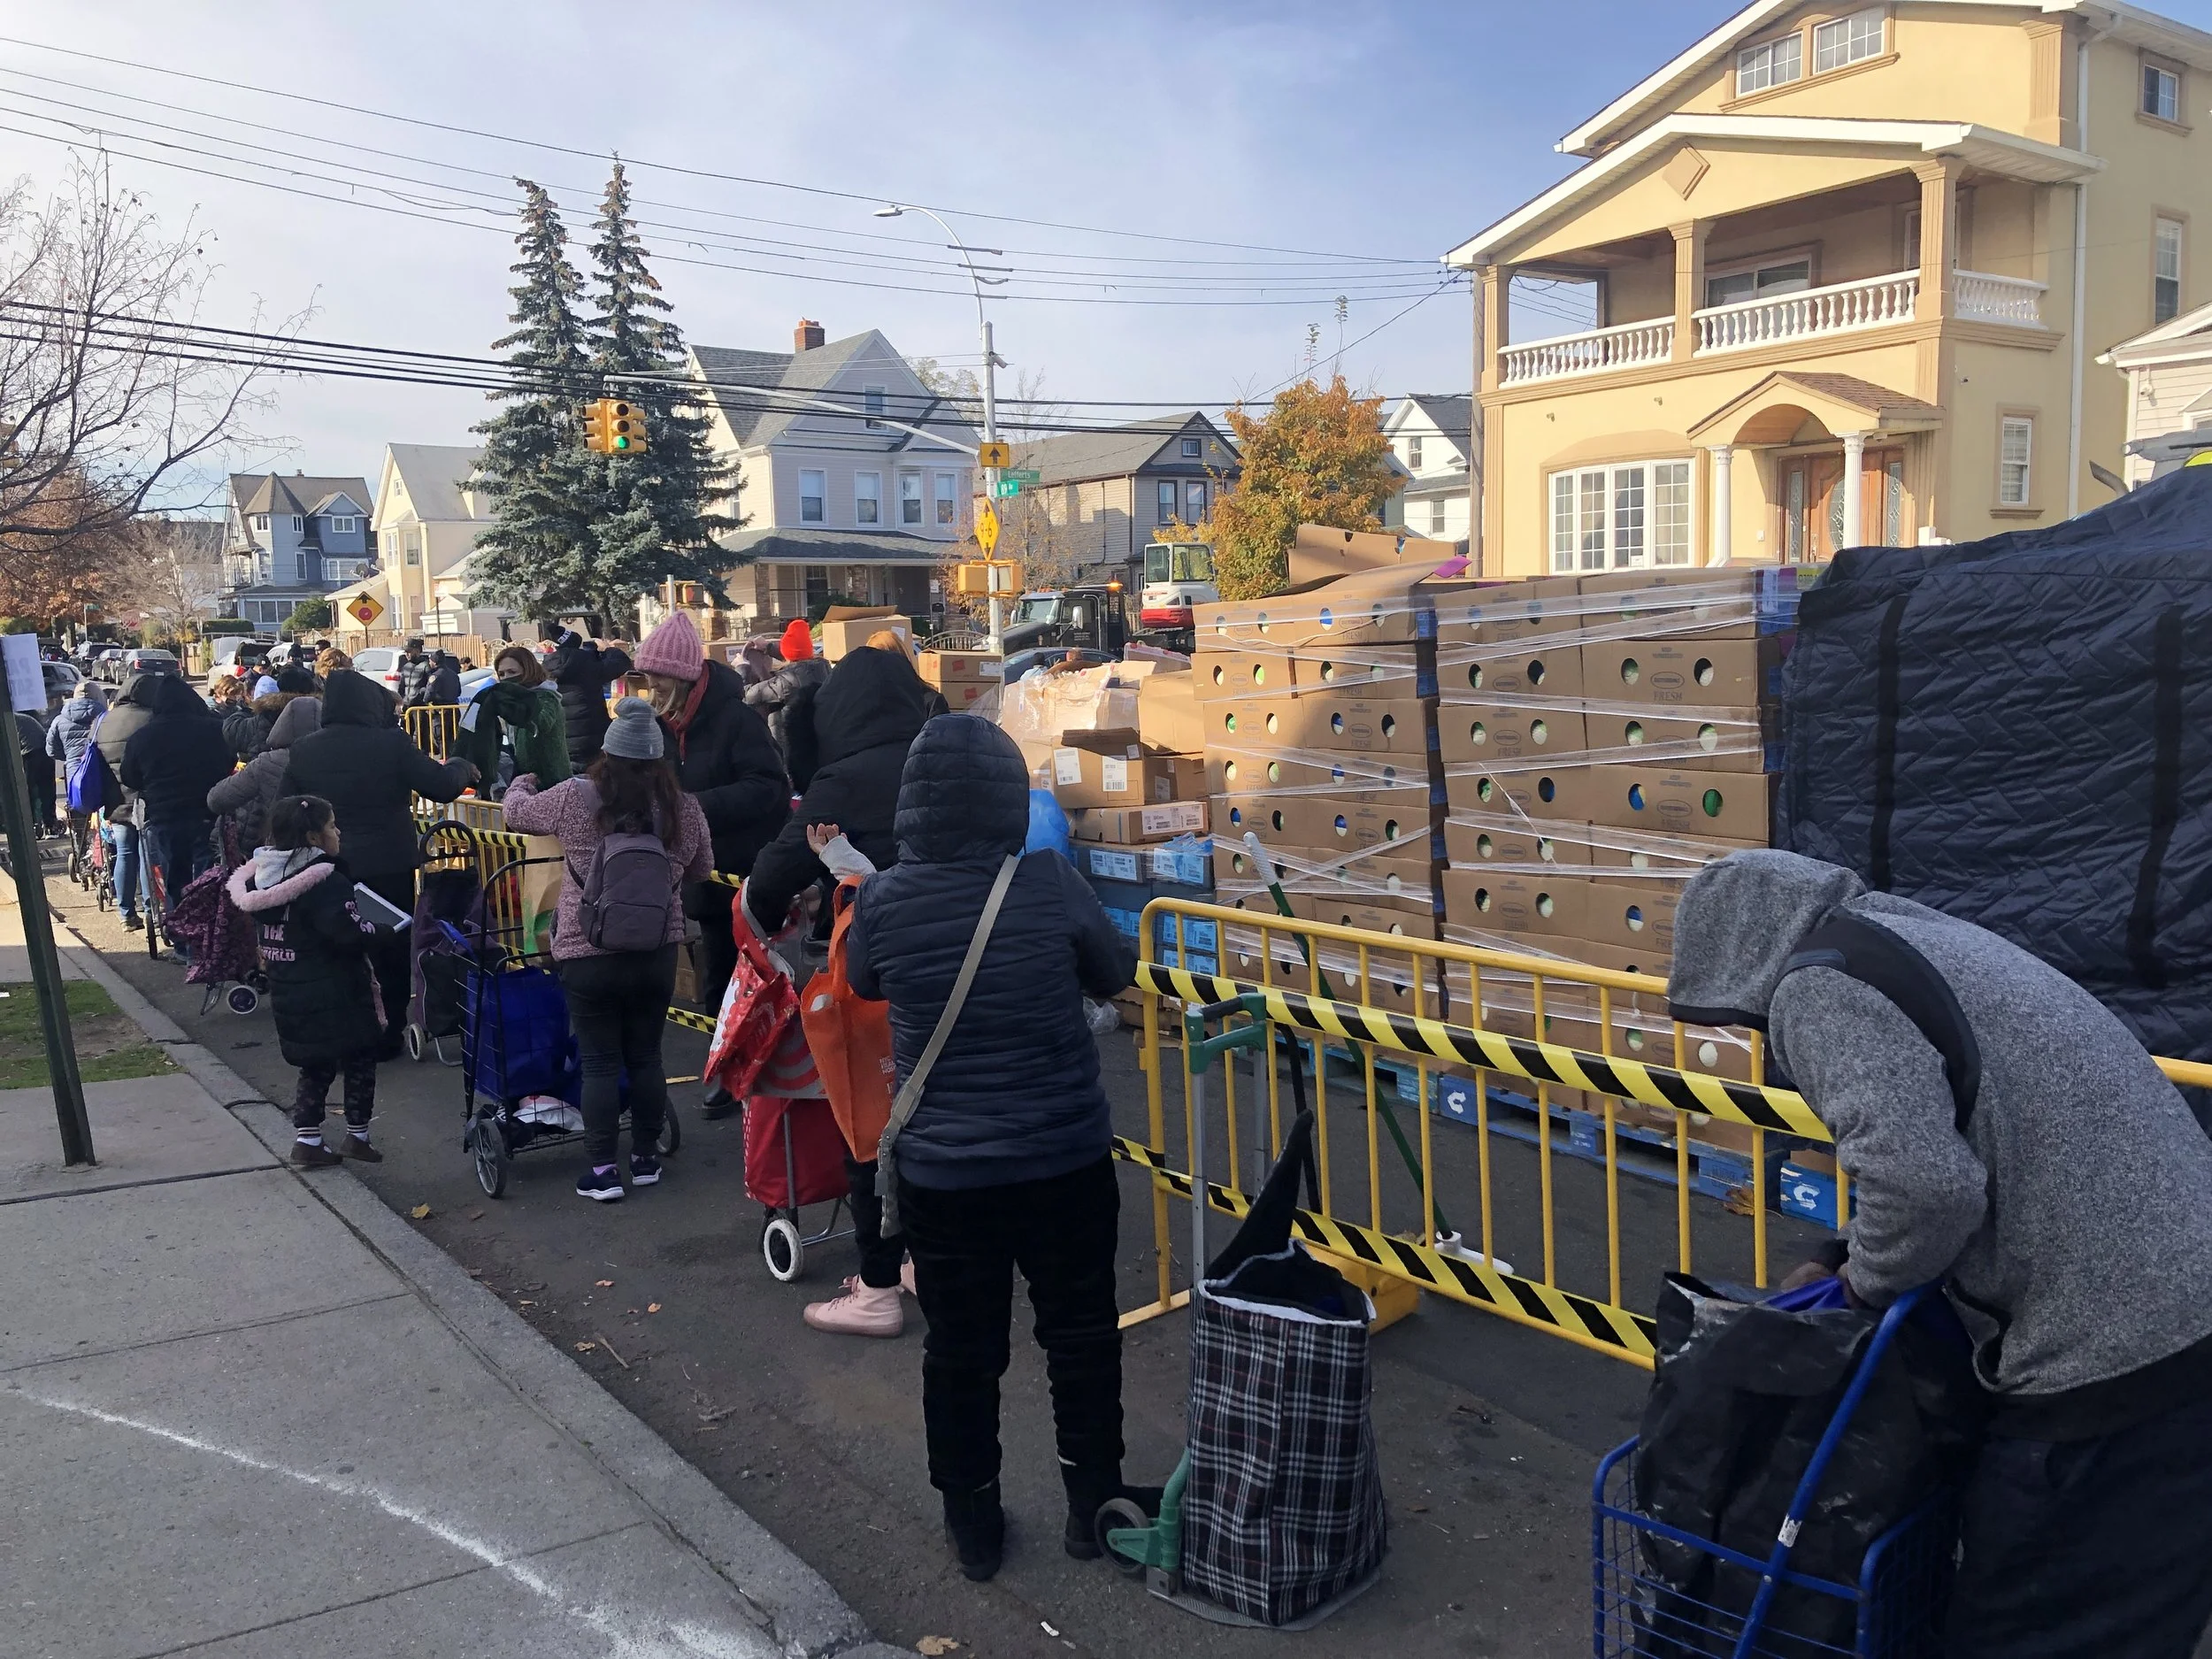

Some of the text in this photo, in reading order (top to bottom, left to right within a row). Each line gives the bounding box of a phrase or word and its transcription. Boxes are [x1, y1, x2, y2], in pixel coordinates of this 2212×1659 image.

[1008, 470, 1031, 479] Lefferts
[1654, 691, 1683, 702] FRESH
[263, 924, 284, 941] THE
